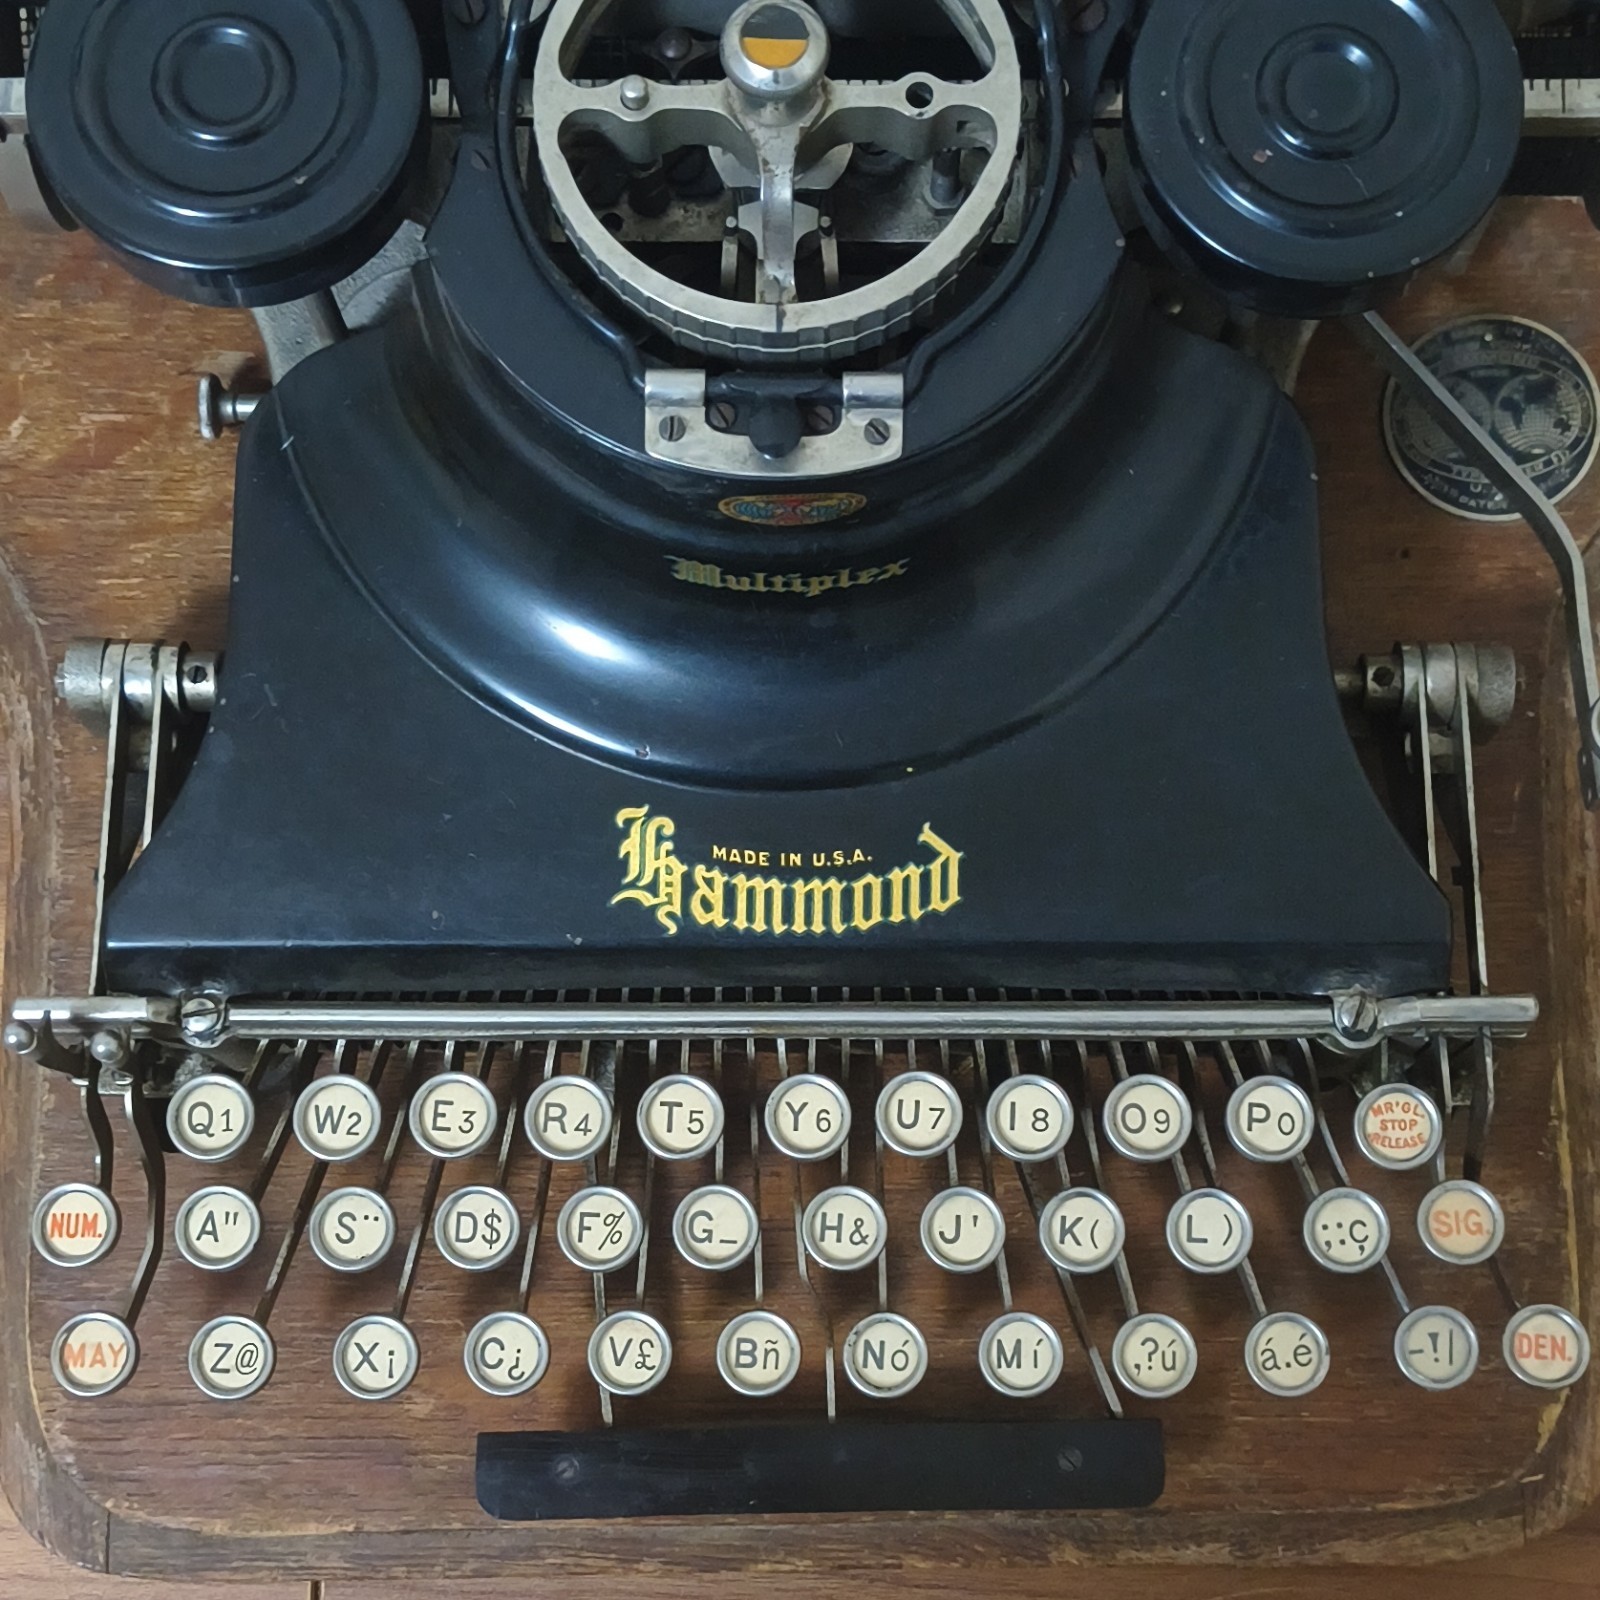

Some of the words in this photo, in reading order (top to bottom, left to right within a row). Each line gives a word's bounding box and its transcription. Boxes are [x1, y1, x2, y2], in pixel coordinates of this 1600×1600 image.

[663, 555, 911, 598] Multiplex
[606, 803, 964, 937] Hammond
[712, 844, 771, 867] MADE
[780, 852, 802, 867] IN
[812, 848, 874, 868] U.S.A.
[1379, 1118, 1418, 1132] STOP
[1367, 1132, 1426, 1149] RELEASE
[49, 1212, 103, 1240] NUM.
[1432, 1209, 1490, 1238] SIG.
[64, 1341, 126, 1369] MAY
[1516, 1333, 1573, 1363] DEN.
